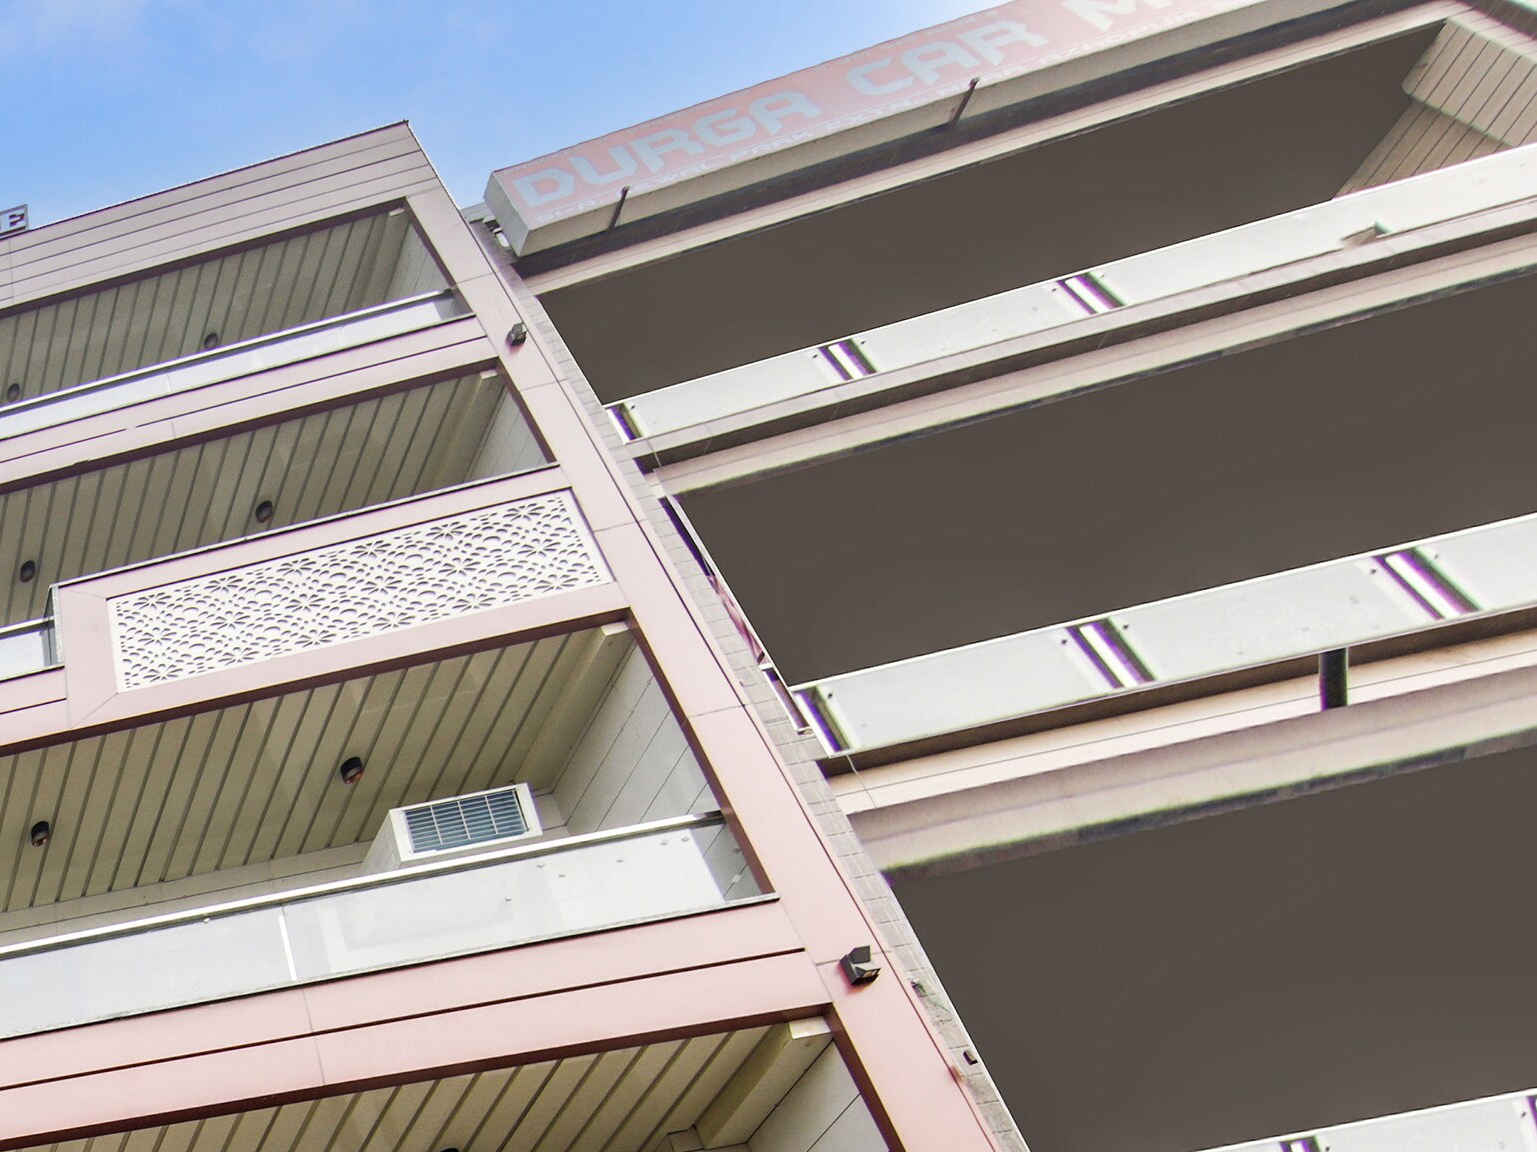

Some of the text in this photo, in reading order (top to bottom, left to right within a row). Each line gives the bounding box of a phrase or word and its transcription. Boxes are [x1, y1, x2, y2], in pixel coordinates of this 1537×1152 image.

[514, 91, 823, 208] DURGA
[846, 20, 1050, 95] CAR
[731, 130, 813, 162] PARK
